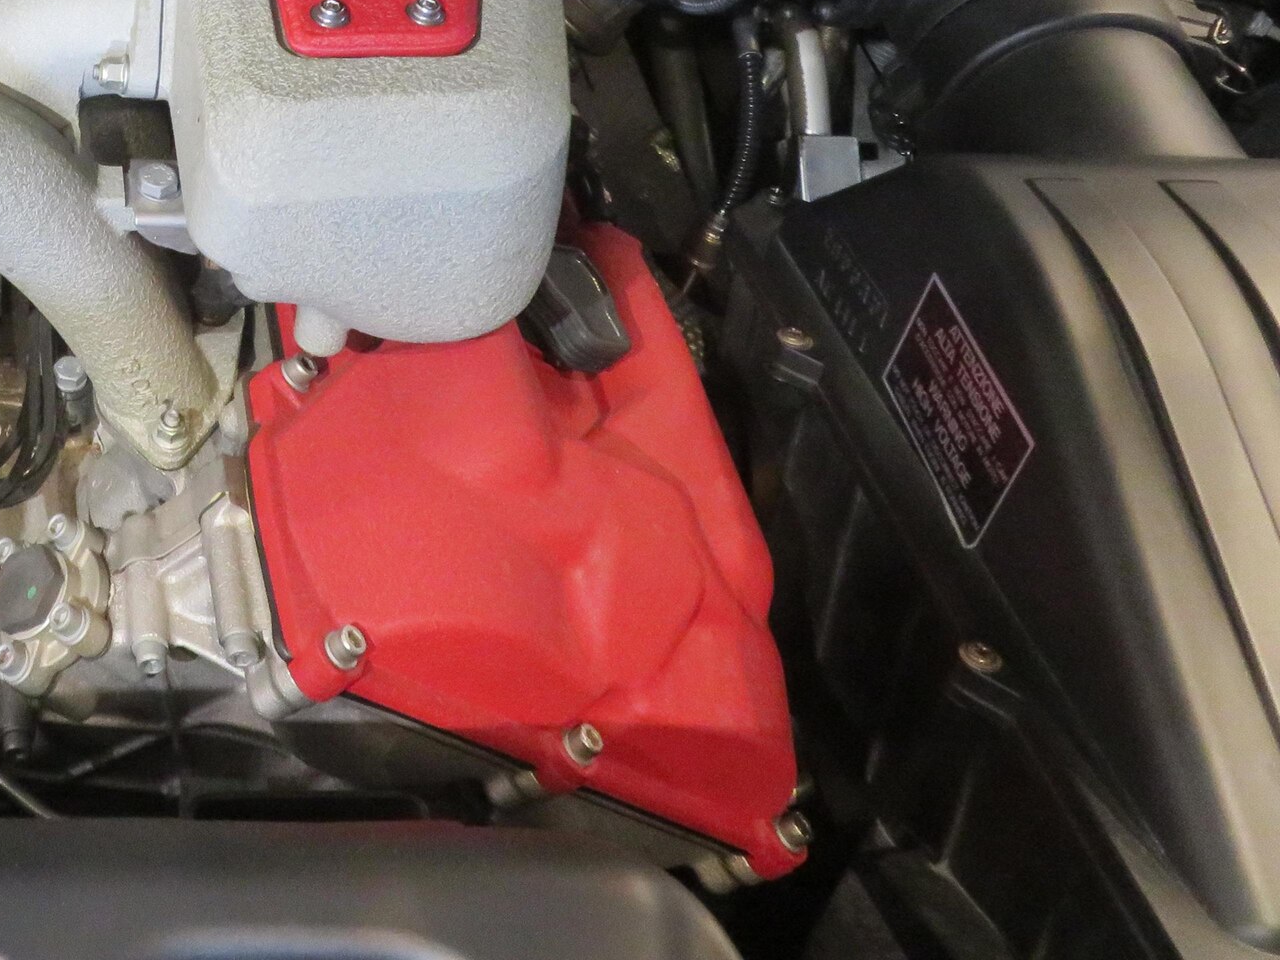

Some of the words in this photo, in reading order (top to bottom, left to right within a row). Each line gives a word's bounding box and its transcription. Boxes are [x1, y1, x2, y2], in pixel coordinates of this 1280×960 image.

[935, 327, 956, 365] ALTA
[957, 360, 1001, 444] TENSIONE
[948, 325, 1005, 419] ATTENZIONE
[929, 379, 968, 451] WARNING
[934, 418, 972, 489] VOLTAGE
